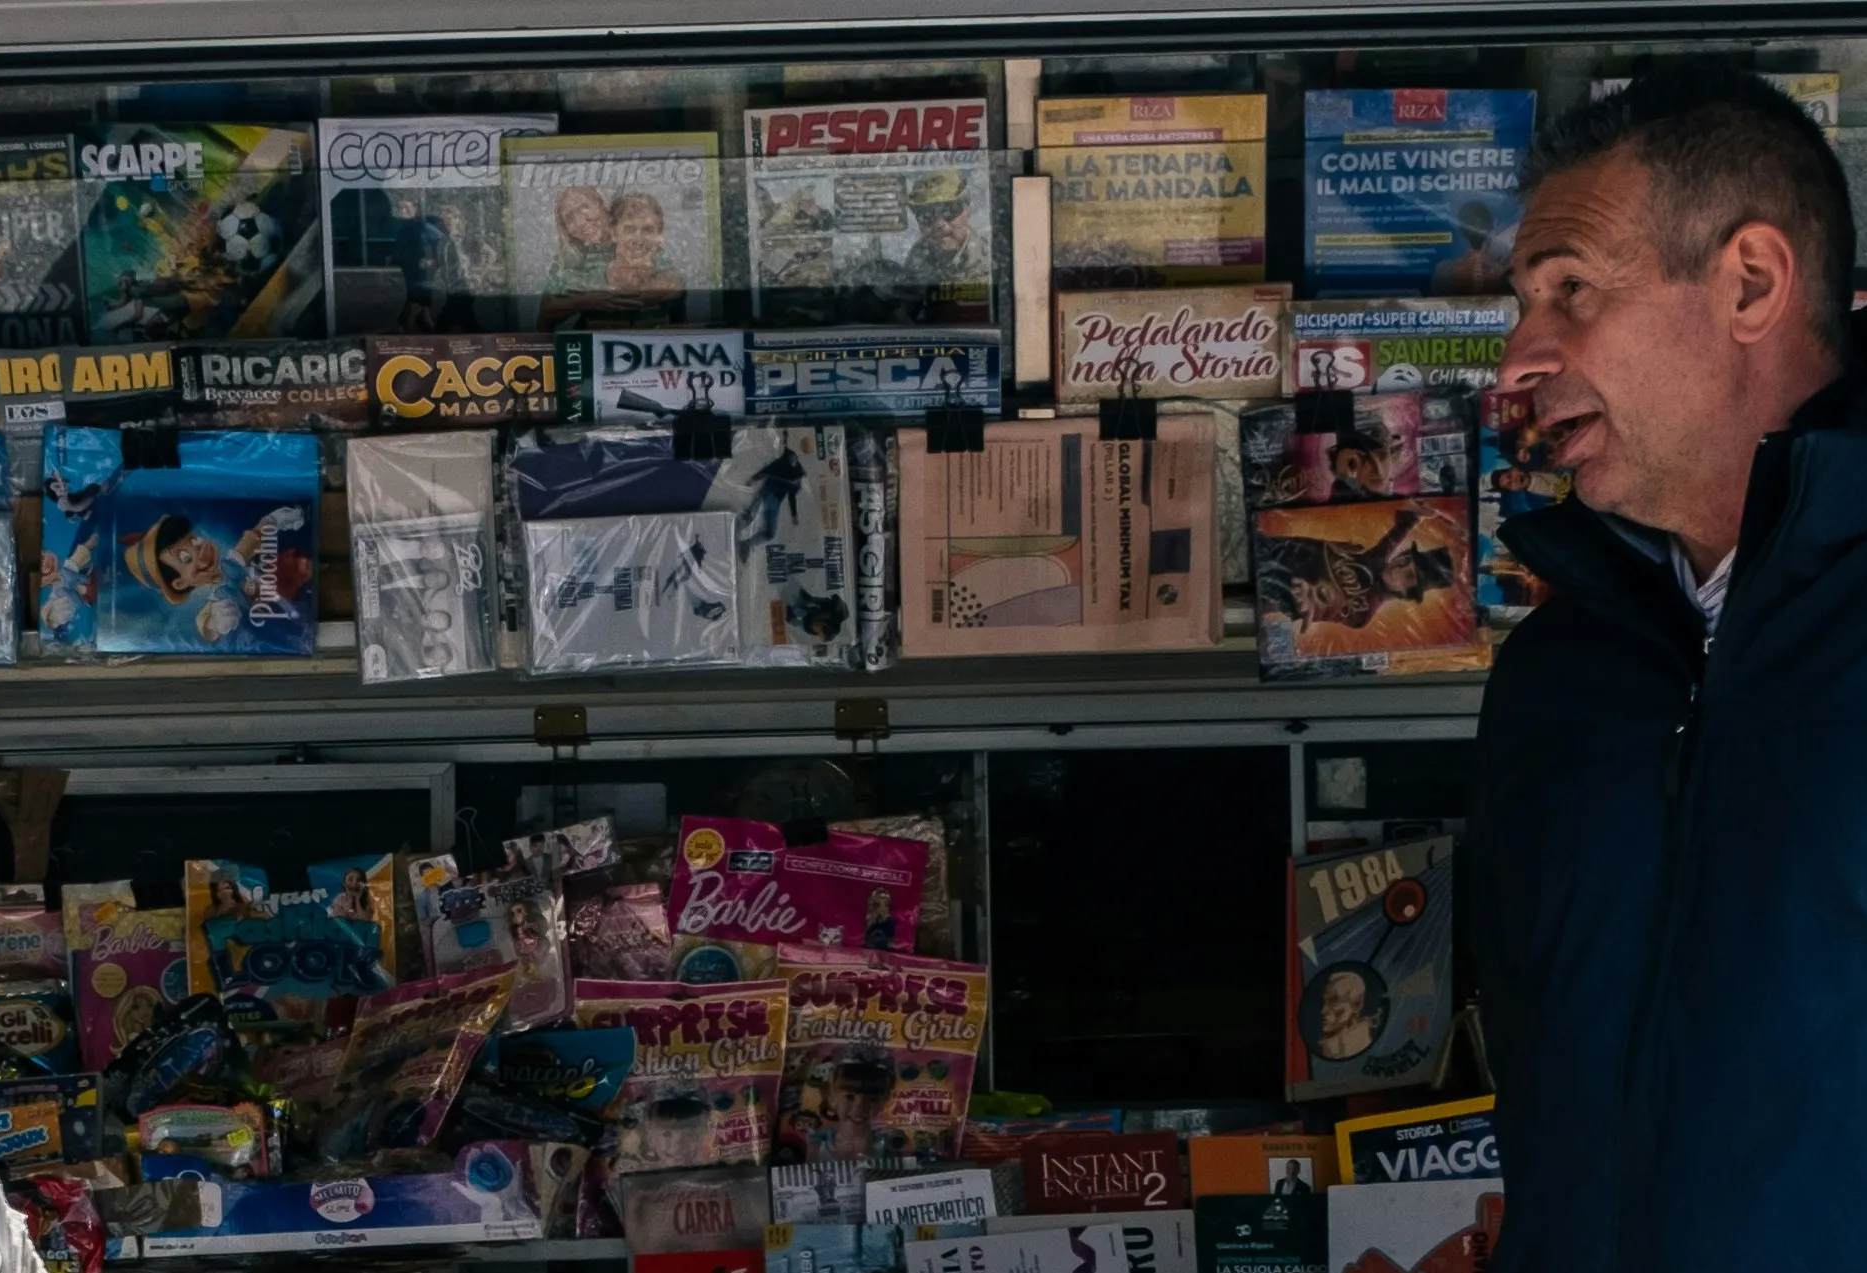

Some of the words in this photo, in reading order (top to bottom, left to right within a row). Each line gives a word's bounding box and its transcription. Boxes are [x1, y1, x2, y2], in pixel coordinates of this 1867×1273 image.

[1397, 101, 1444, 121] RIZA
[767, 105, 982, 156] PESCARE
[81, 141, 203, 181] SCARPE
[1321, 150, 1397, 173] COME
[1402, 147, 1515, 170] VINCERE
[1317, 176, 1337, 197] IL
[1341, 175, 1388, 195] MAL
[1418, 169, 1520, 192] SCHIENA
[1073, 306, 1275, 356] Pedalando
[601, 338, 732, 377] DIANA
[1166, 345, 1278, 386] Storia
[1379, 338, 1507, 366] SANREMO
[1117, 441, 1132, 506] GLOBAL
[1117, 507, 1132, 578] MINIMUM
[1117, 580, 1132, 612] TAX
[676, 870, 807, 935] Barbie
[1309, 849, 1405, 924] 1984
[903, 1014, 978, 1043] Girls
[1396, 1125, 1444, 1141] STORICA
[1041, 1148, 1164, 1181] INSTANT
[1144, 1173, 1169, 1208] 2
